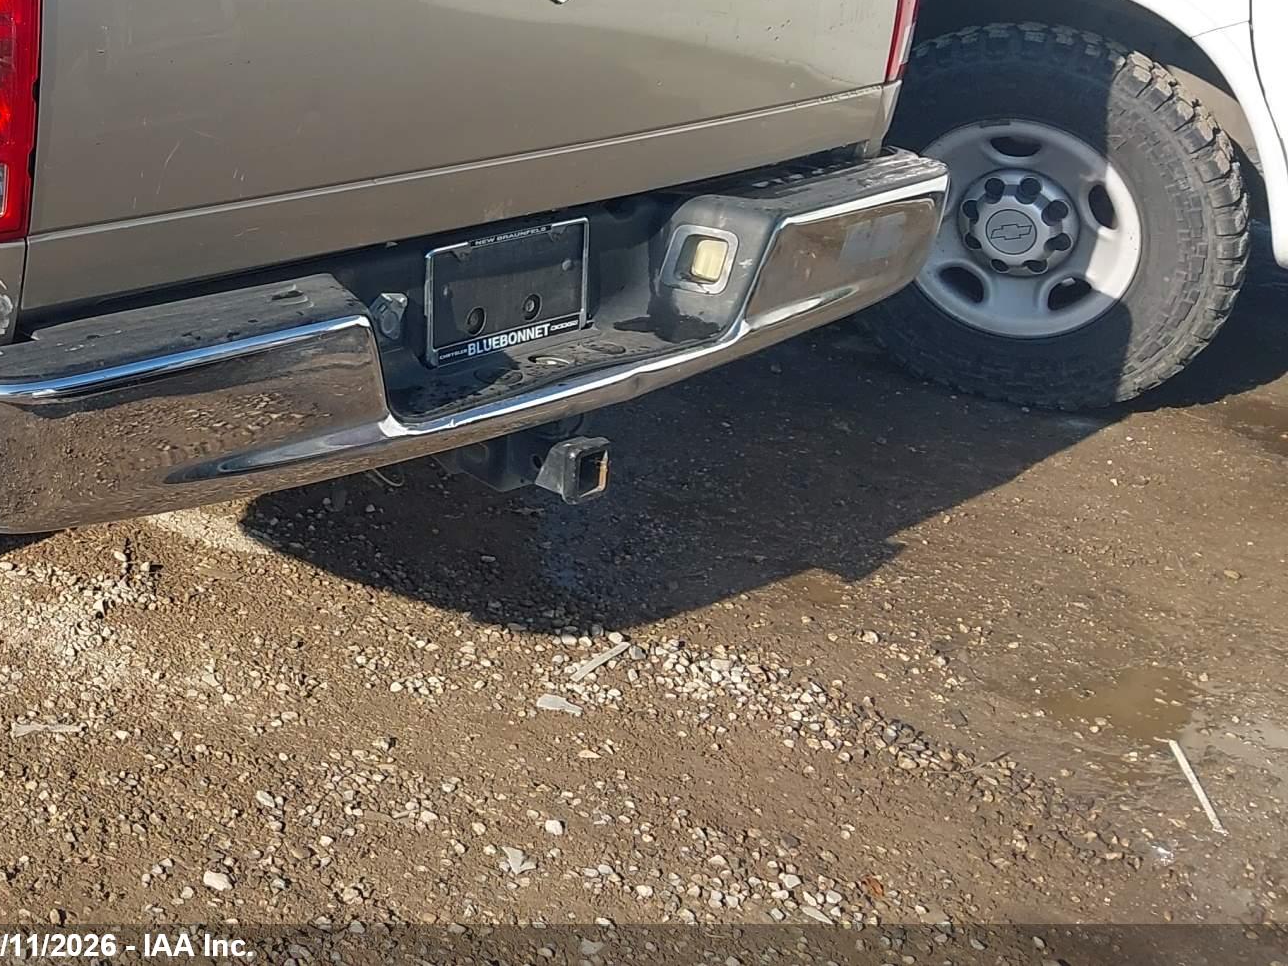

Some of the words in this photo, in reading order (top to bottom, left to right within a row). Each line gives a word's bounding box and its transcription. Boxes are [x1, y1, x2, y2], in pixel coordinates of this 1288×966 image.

[475, 237, 495, 246] NEW
[496, 226, 547, 241] BRAUNFELS
[467, 323, 551, 356] BLUEBONNET
